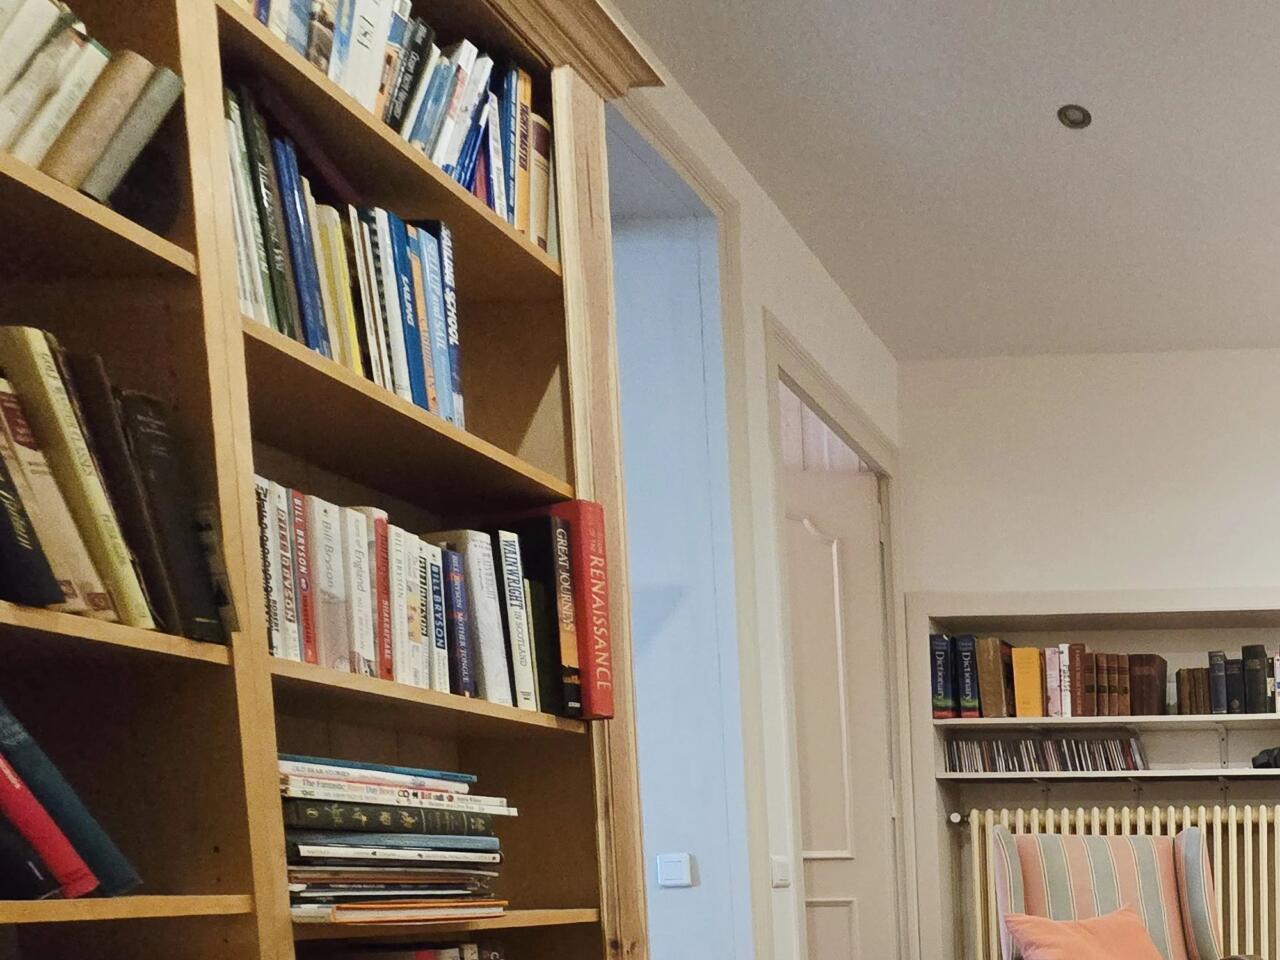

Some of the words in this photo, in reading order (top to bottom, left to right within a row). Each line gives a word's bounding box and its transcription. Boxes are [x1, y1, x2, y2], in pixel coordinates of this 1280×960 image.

[518, 101, 530, 172] YACHTMASTER
[441, 222, 456, 289] SAILING
[401, 274, 415, 328] SAILING
[445, 286, 460, 346] SCHOOL
[293, 498, 304, 525] BILL
[322, 519, 333, 541] Bill
[296, 530, 309, 575] BRYSON
[323, 541, 336, 590] Bryson
[353, 549, 367, 593] England
[451, 554, 460, 574] BILL
[556, 528, 569, 570] GREAT
[281, 553, 296, 624] BRYSON
[431, 564, 440, 588] BILL
[453, 575, 464, 611] BRYSON
[558, 567, 575, 633] JOURNEYS
[433, 589, 445, 648] BRYSON
[503, 540, 525, 610] WAINWRIGHT
[514, 622, 527, 667] SCOTLAND
[589, 555, 612, 691] RENAISSANCE
[381, 600, 392, 659] SHAKESPEARE
[456, 612, 466, 647] MOTHER
[459, 647, 469, 683] TONGUE
[935, 651, 945, 700] Dictionary
[961, 651, 972, 700] Dictionary
[302, 779, 315, 788] The
[316, 779, 345, 791] Fantastic
